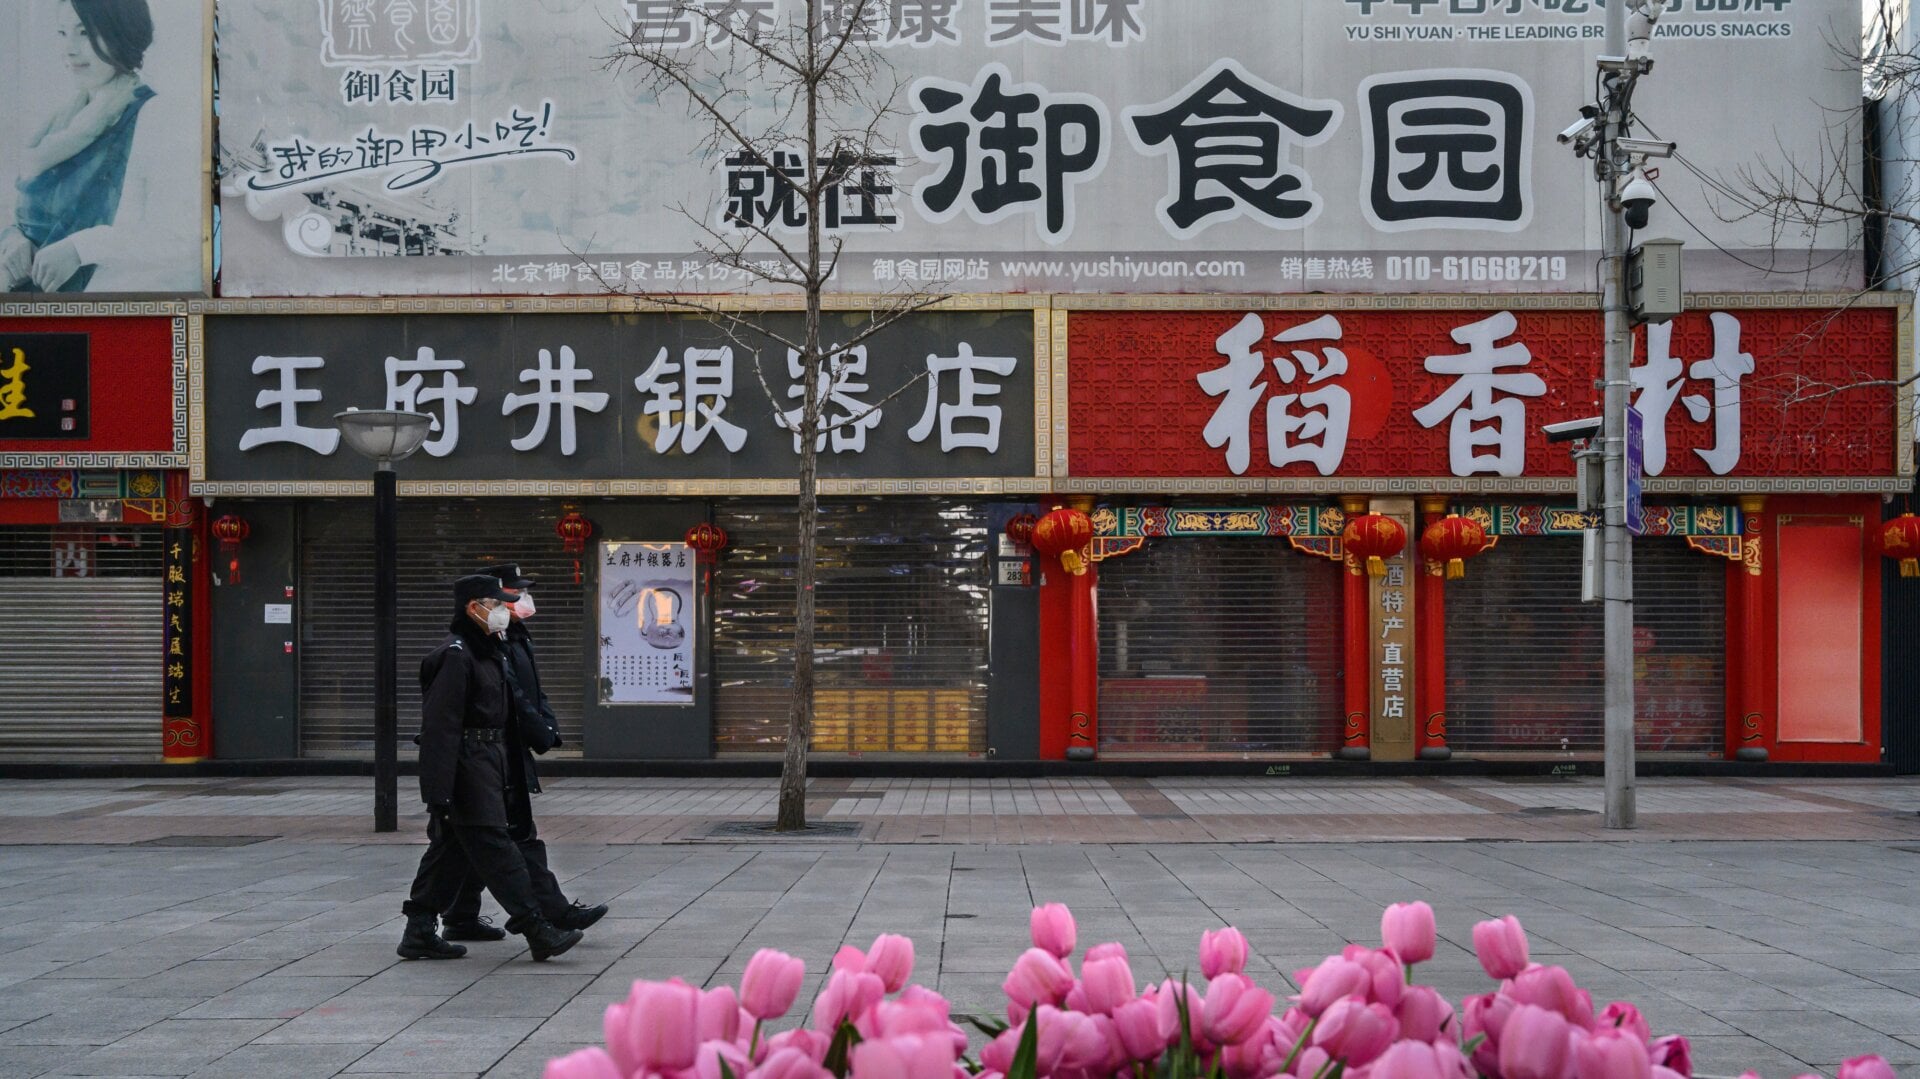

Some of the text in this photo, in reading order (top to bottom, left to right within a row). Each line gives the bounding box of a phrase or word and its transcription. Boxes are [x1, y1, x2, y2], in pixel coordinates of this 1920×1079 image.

[1345, 25, 1369, 39] YU
[1373, 25, 1401, 39] SHI
[1406, 25, 1453, 39] YUAN
[1467, 25, 1501, 39] THE
[1505, 25, 1577, 39] LEADING
[1653, 23, 1716, 37] AMOUS
[1721, 23, 1791, 37] SNACKS
[344, 68, 455, 102] 御食园
[918, 68, 1525, 234] 御食园
[872, 256, 1245, 283] 御食园网站 www.yushiyuan.com
[1281, 255, 1567, 281] 销售热线 010-61668219
[238, 342, 1018, 458] 王府井银器店
[1197, 310, 1757, 478] 稻香村
[1381, 550, 1405, 719] 酒特产直营店
